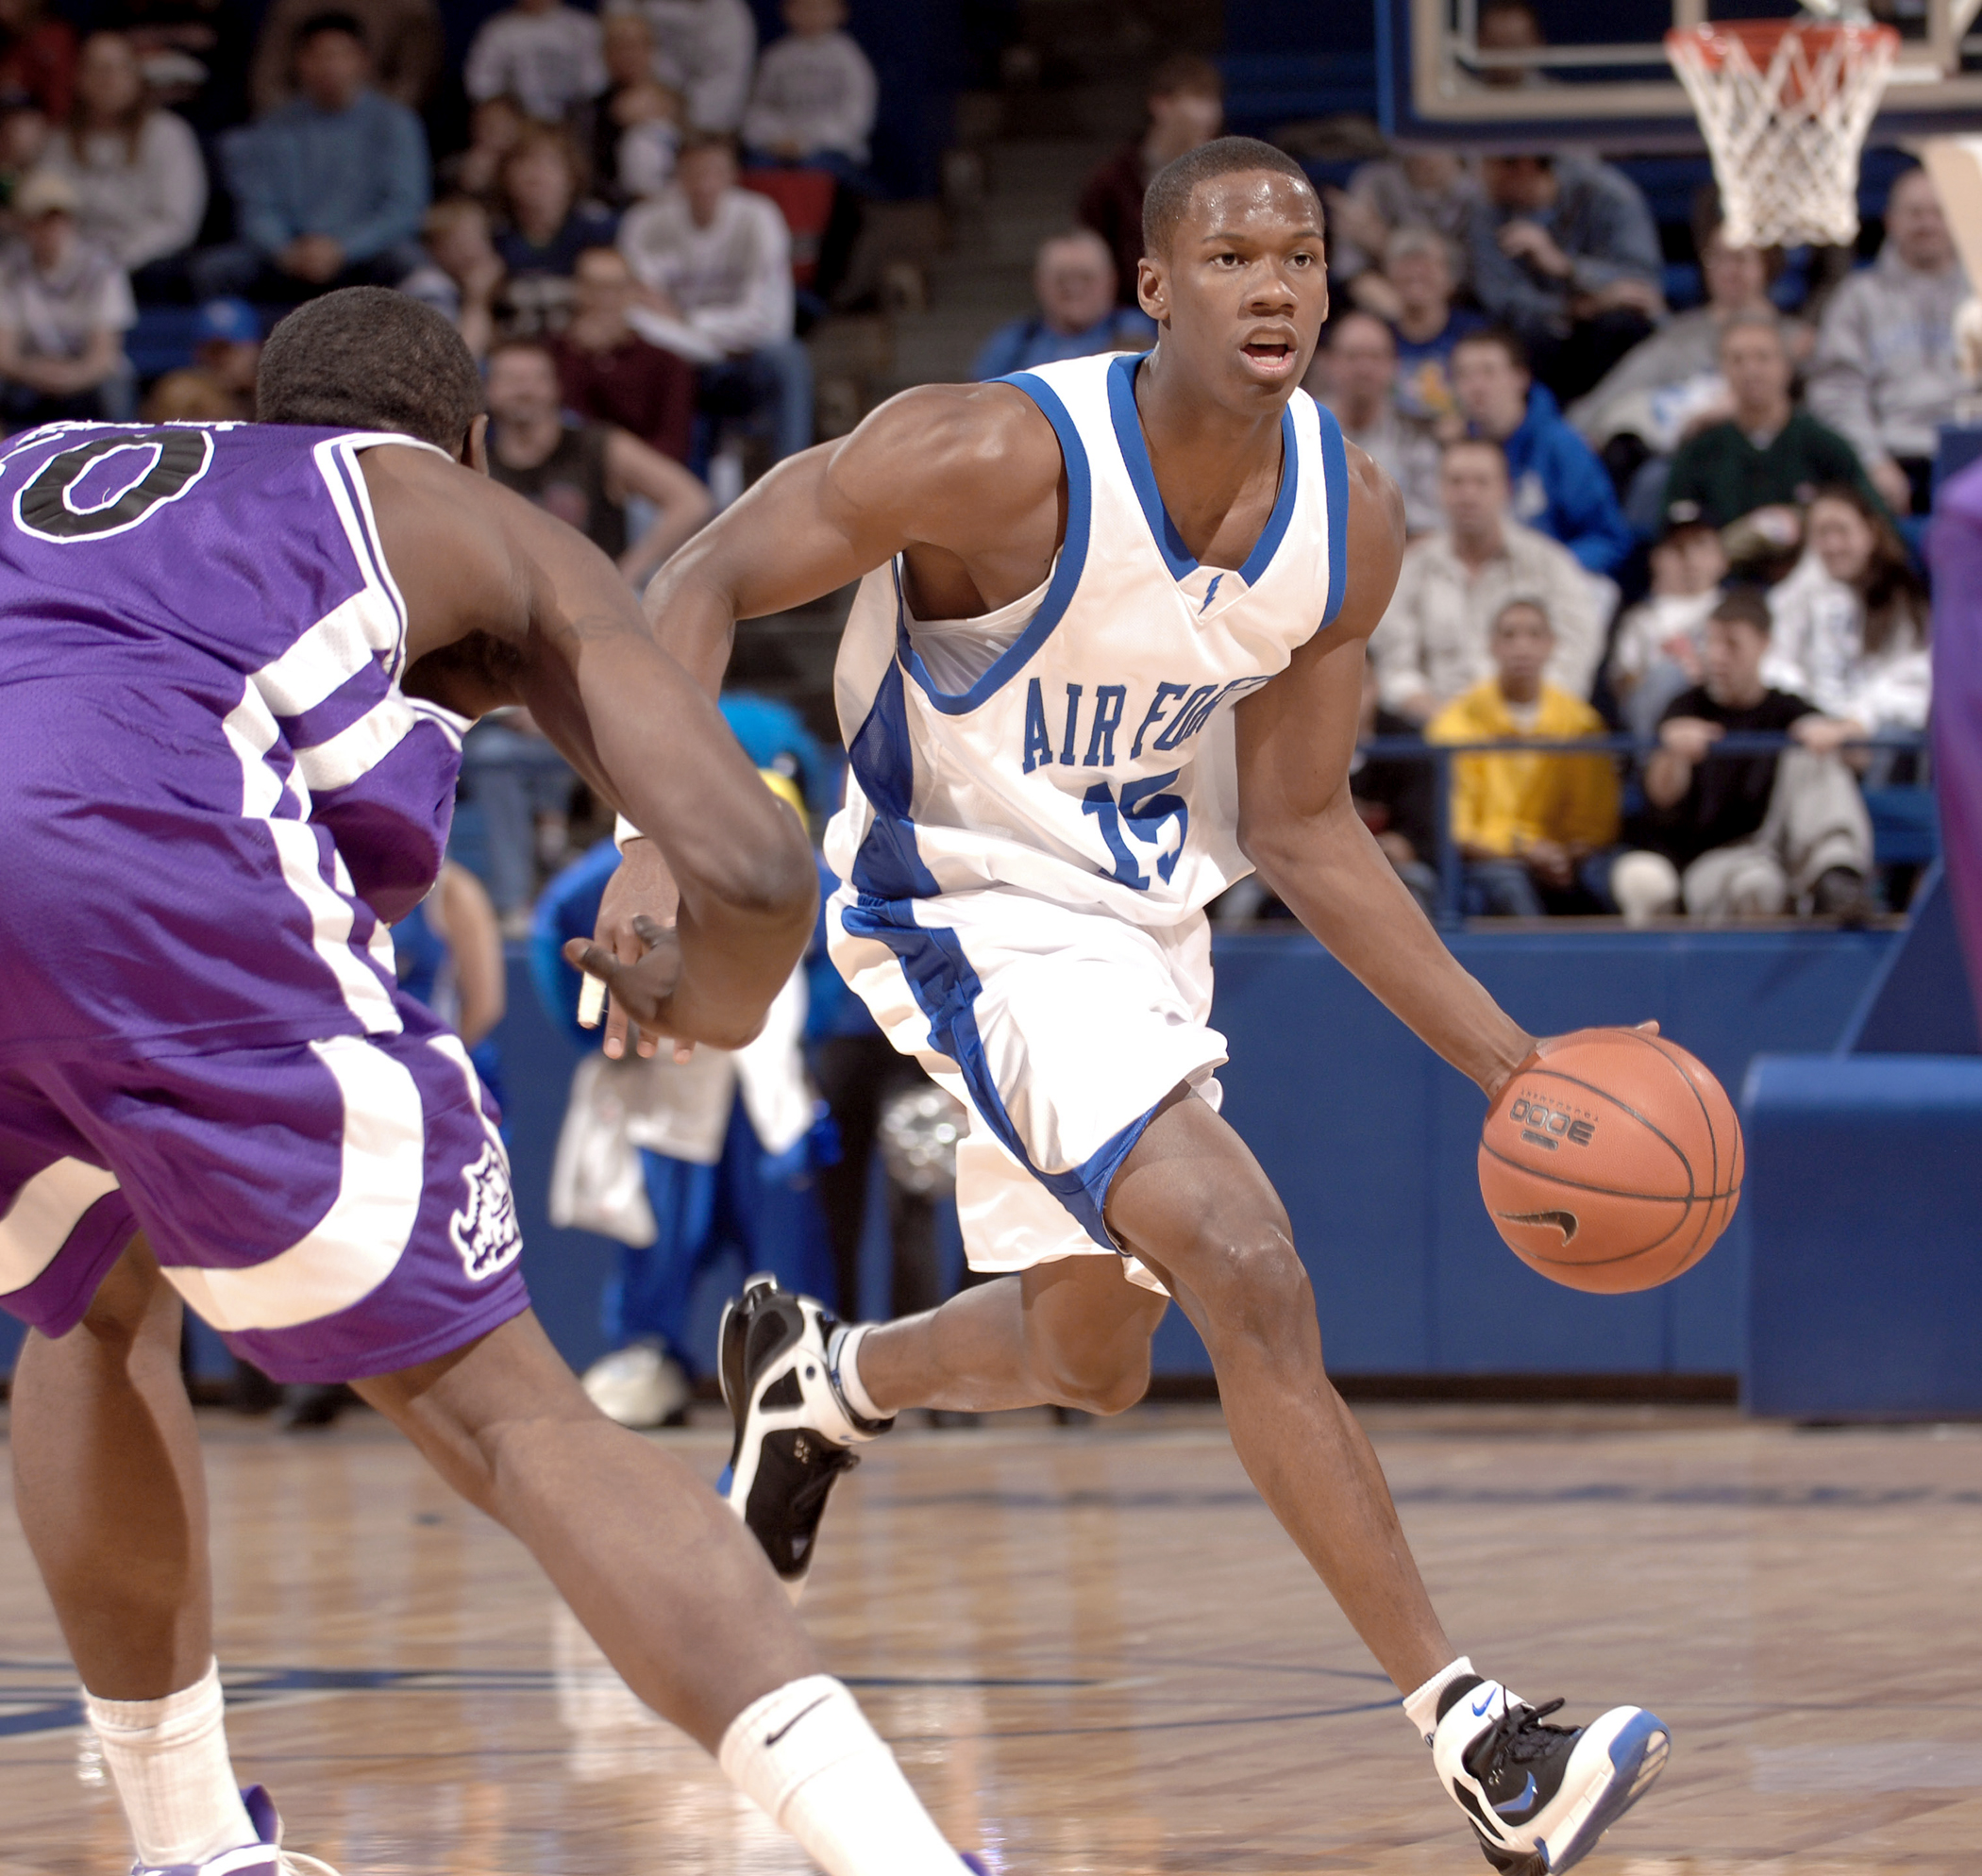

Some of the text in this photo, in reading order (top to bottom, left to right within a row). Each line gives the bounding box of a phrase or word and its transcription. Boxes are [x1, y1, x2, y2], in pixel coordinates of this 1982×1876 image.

[1022, 677, 1127, 776] AIR
[1082, 768, 1187, 890] 15
[1510, 1098, 1595, 1147] 3000
